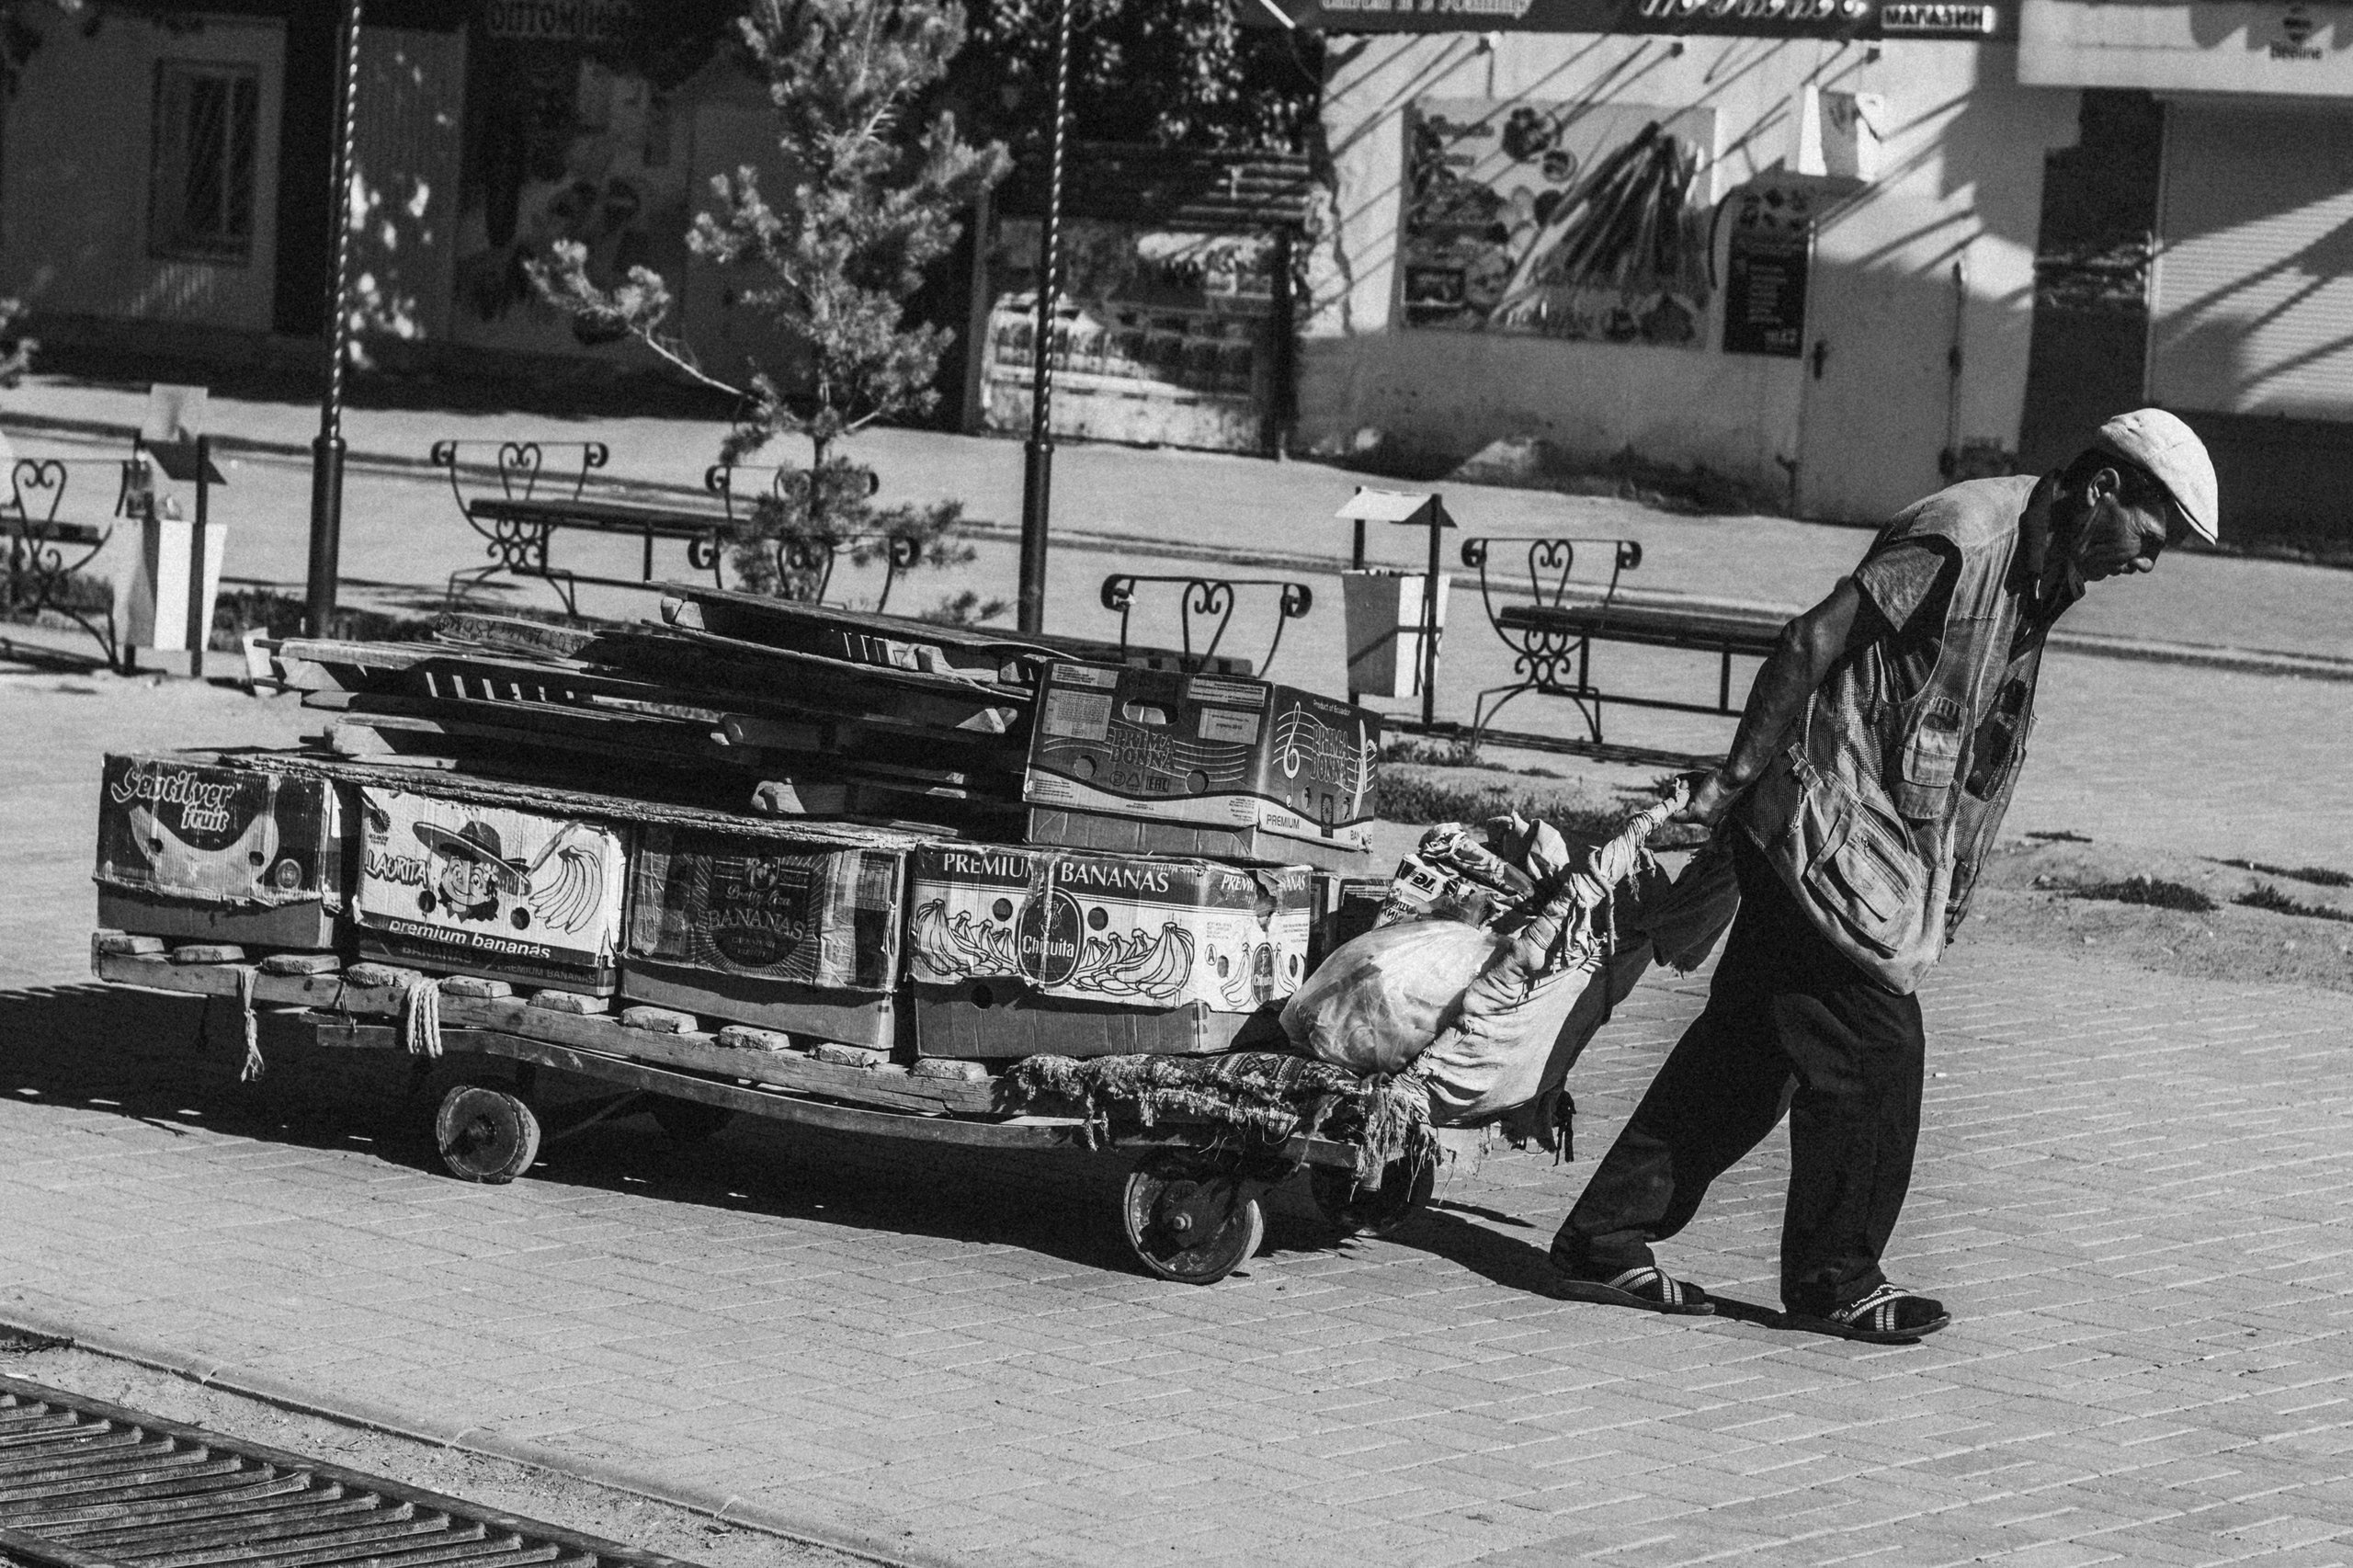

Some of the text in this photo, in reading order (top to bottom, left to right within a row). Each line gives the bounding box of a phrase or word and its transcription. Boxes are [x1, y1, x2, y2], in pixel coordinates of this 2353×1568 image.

[1886, 6, 1982, 26] МАГАЗИН
[1111, 728, 1176, 752] PRIMA
[1312, 723, 1349, 760] PRIMA
[1108, 745, 1176, 770] DONNA
[1310, 753, 1349, 788] DONNA
[181, 802, 230, 832] fruit
[1267, 813, 1300, 830] PREMIUM
[364, 848, 429, 889] LAURITA
[1060, 861, 1169, 892] BANANAS
[389, 919, 551, 959] premium bananas
[707, 907, 807, 941] BANANAS
